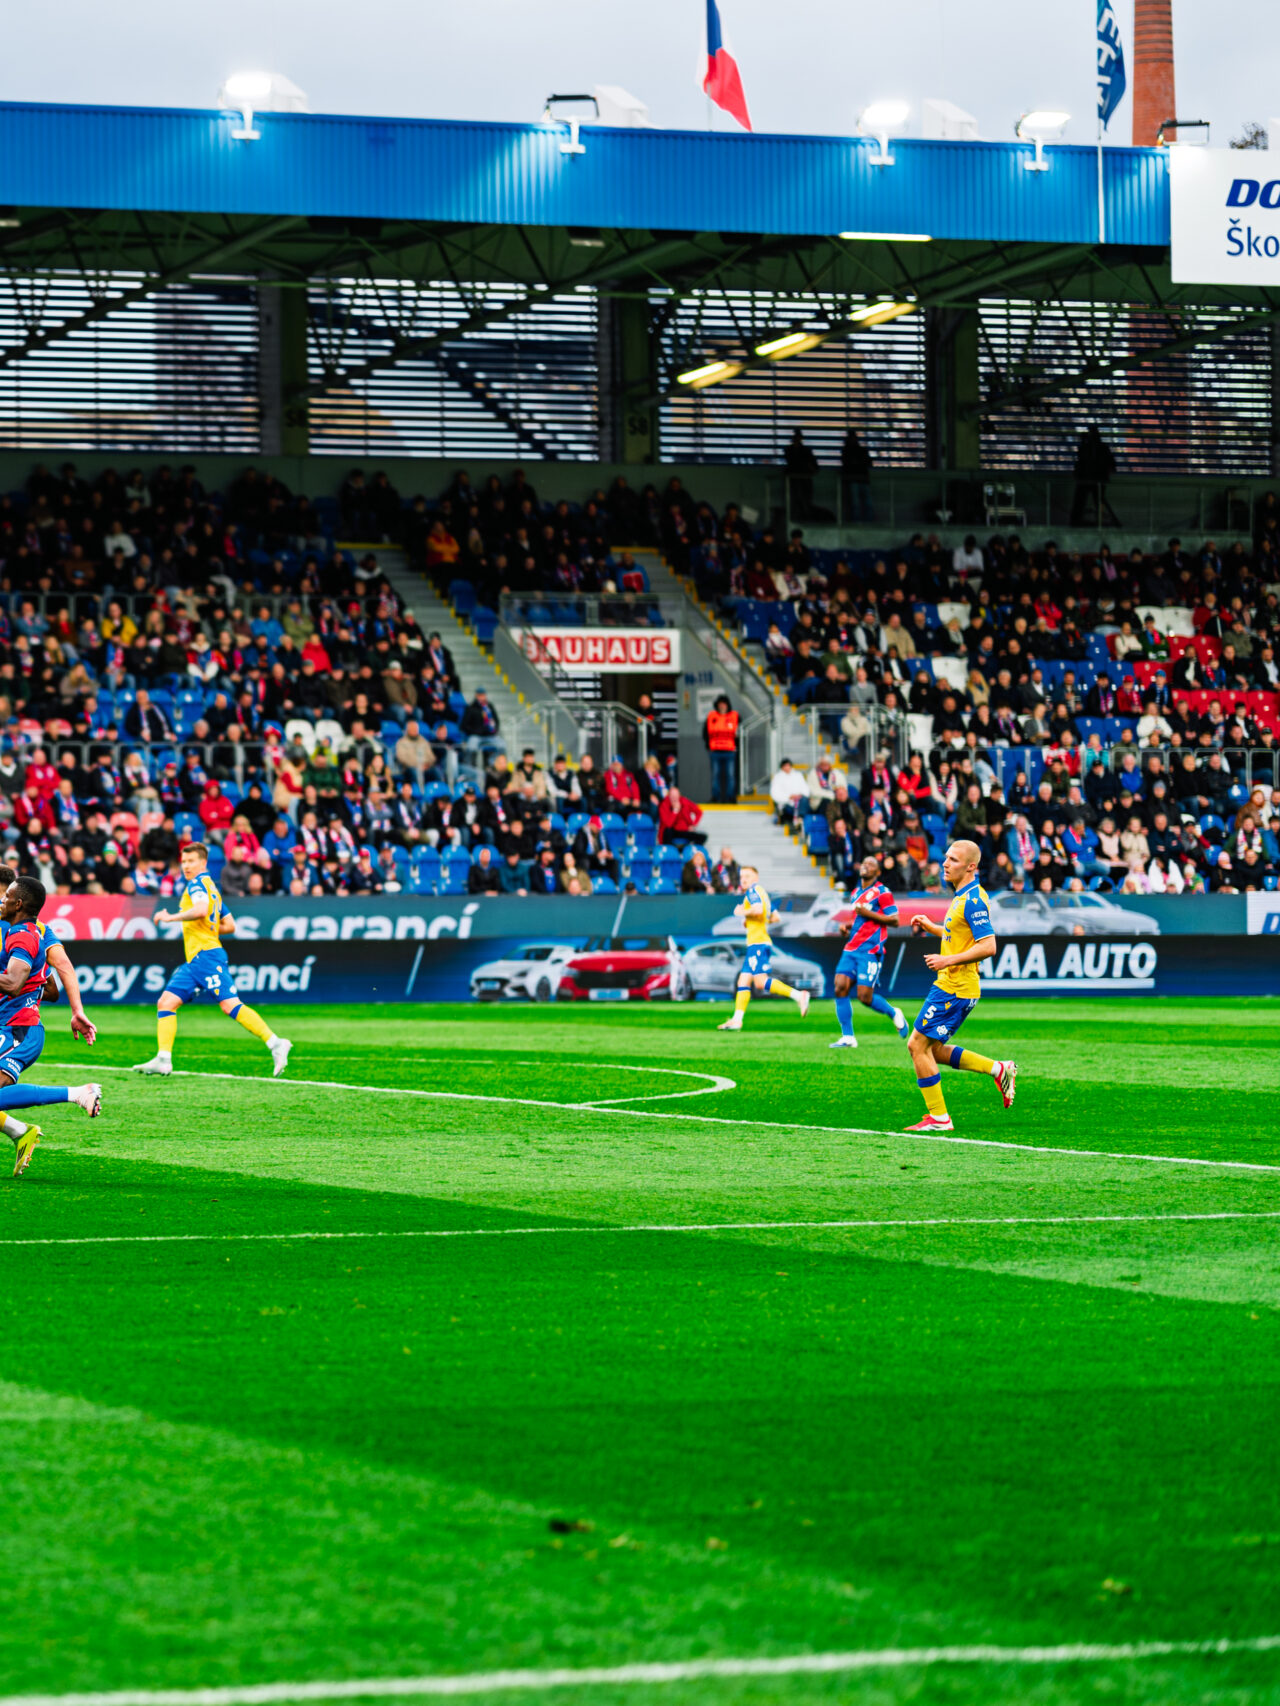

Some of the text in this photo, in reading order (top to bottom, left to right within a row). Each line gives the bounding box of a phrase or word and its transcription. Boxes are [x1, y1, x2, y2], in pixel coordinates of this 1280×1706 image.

[1226, 218, 1280, 257] Ško
[88, 917, 184, 940] voz
[233, 915, 261, 940] s
[1057, 942, 1157, 978] AUTO
[143, 965, 166, 992] s
[205, 974, 221, 989] 23
[924, 1005, 937, 1019] 5
